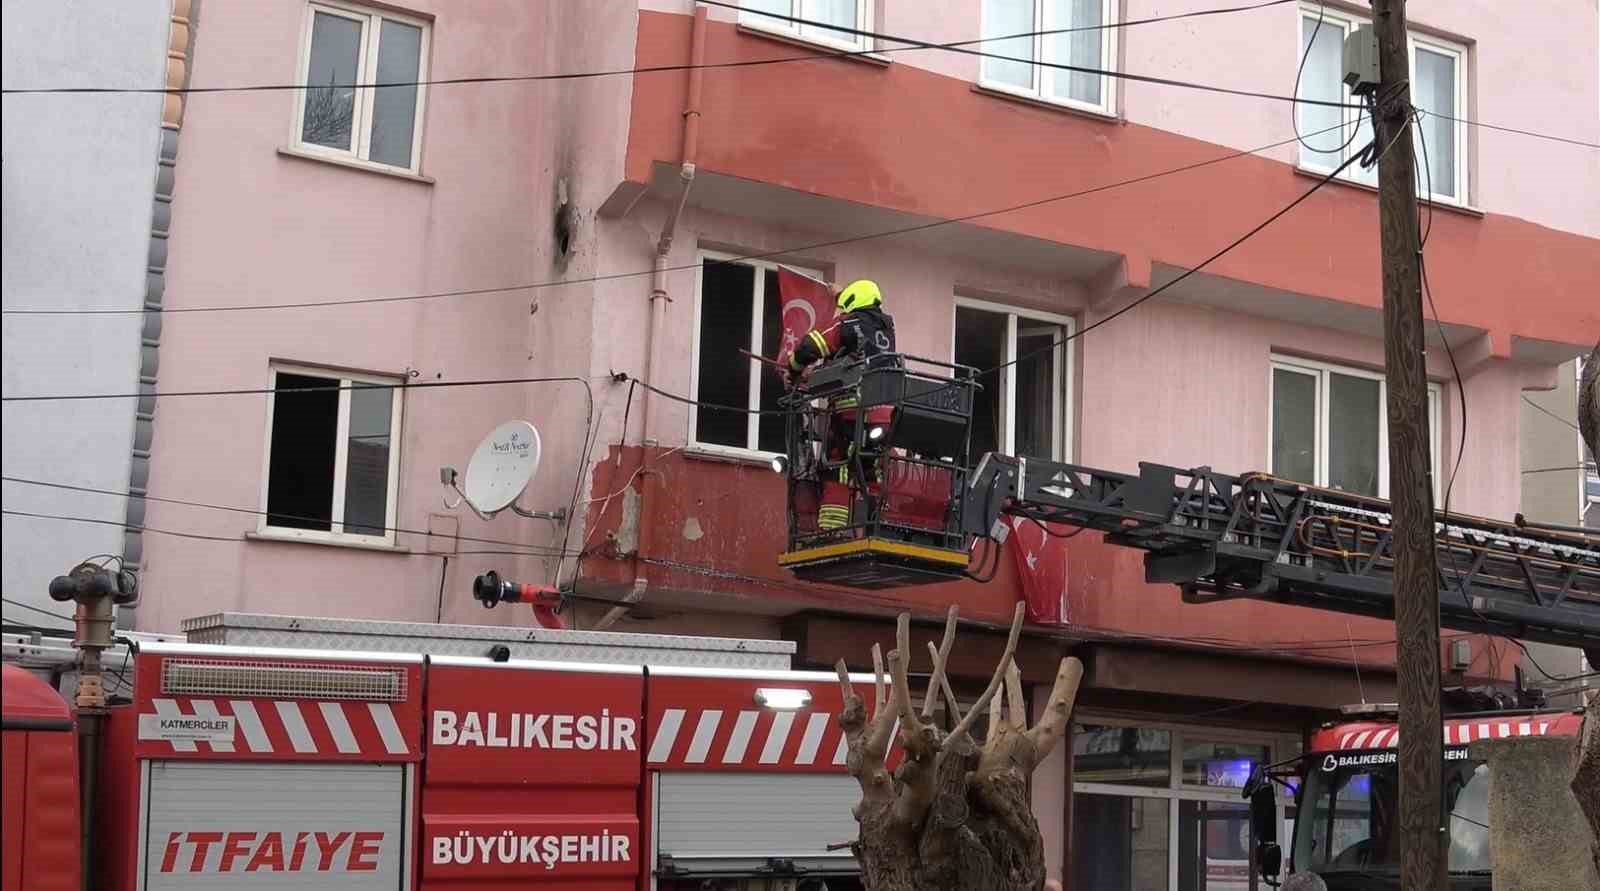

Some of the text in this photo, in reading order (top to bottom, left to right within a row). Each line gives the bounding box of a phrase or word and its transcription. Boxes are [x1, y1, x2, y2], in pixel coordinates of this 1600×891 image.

[432, 708, 637, 751] BALIKESİR
[1338, 752, 1397, 767] BALIKESİR
[160, 832, 385, 873] İTFAİYE
[432, 829, 631, 870] BÜYÜKŞEHİR
